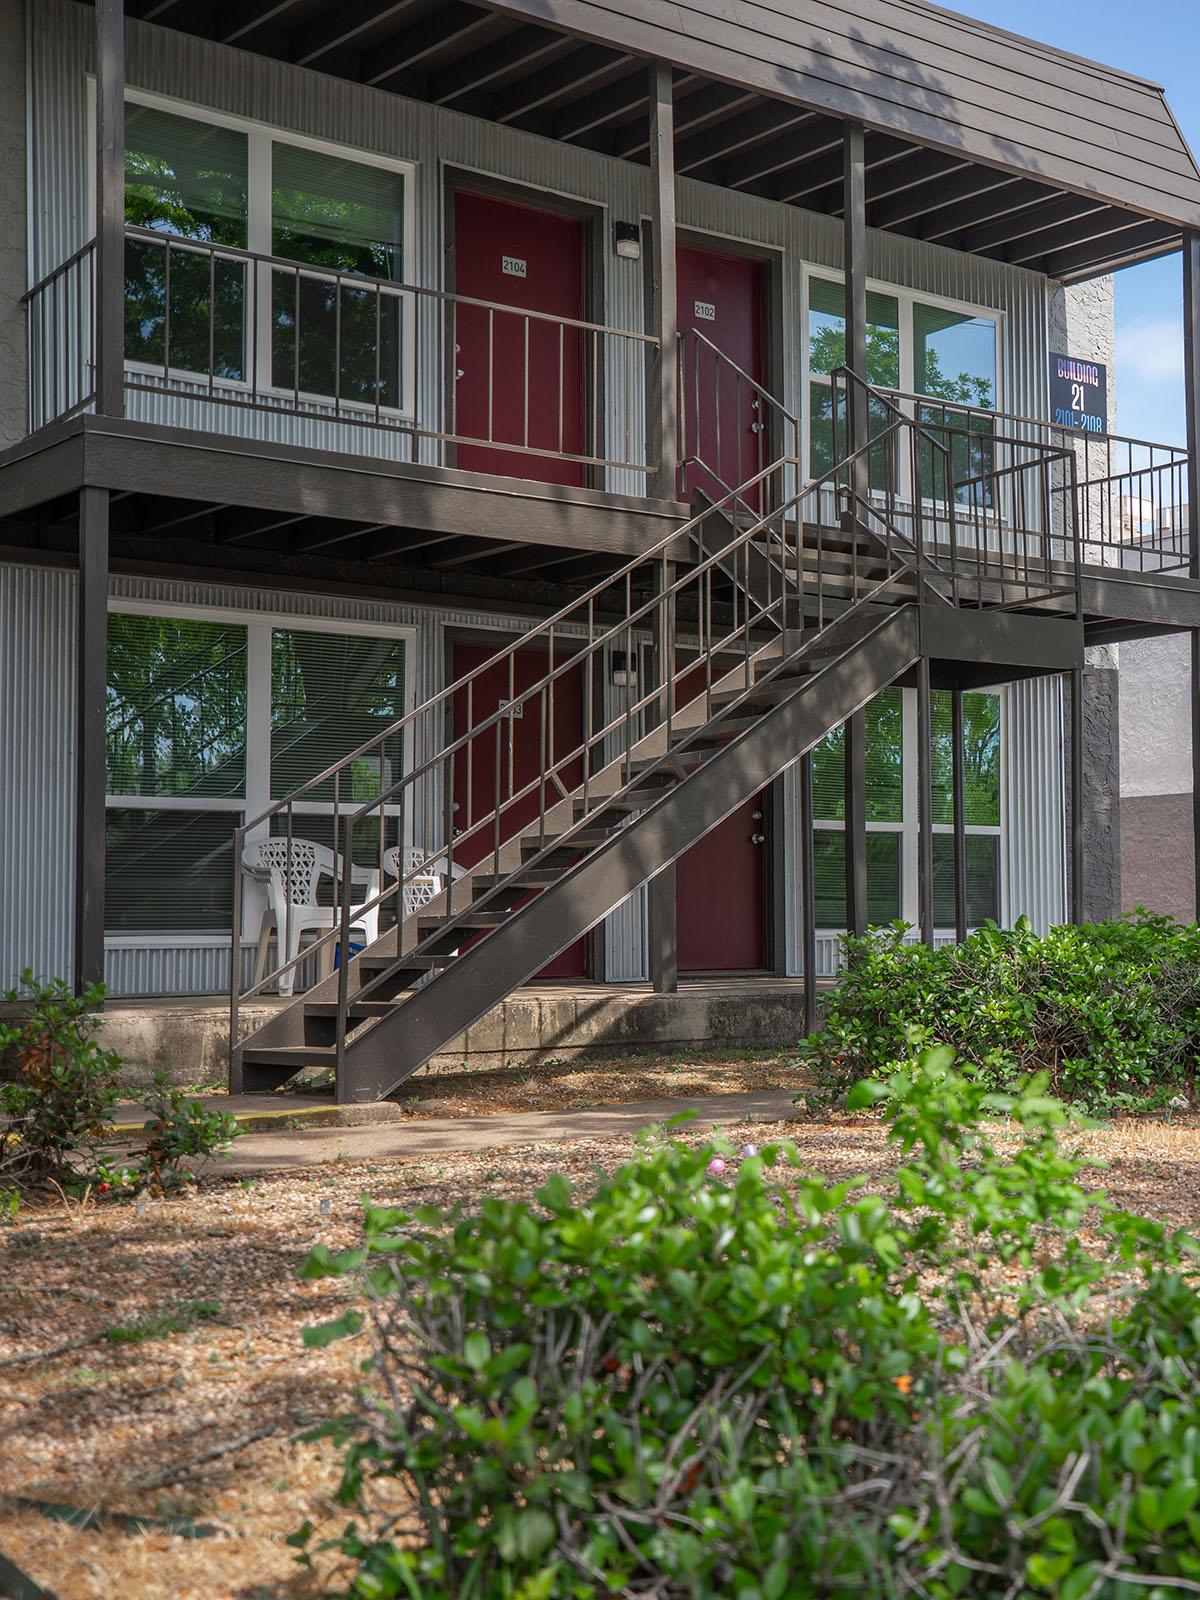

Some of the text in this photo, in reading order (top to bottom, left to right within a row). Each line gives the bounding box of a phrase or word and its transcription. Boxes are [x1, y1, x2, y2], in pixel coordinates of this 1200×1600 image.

[503, 260, 525, 273] 2104
[695, 304, 714, 317] 2102
[1057, 358, 1099, 387] BUILDING
[1071, 383, 1085, 412] 21
